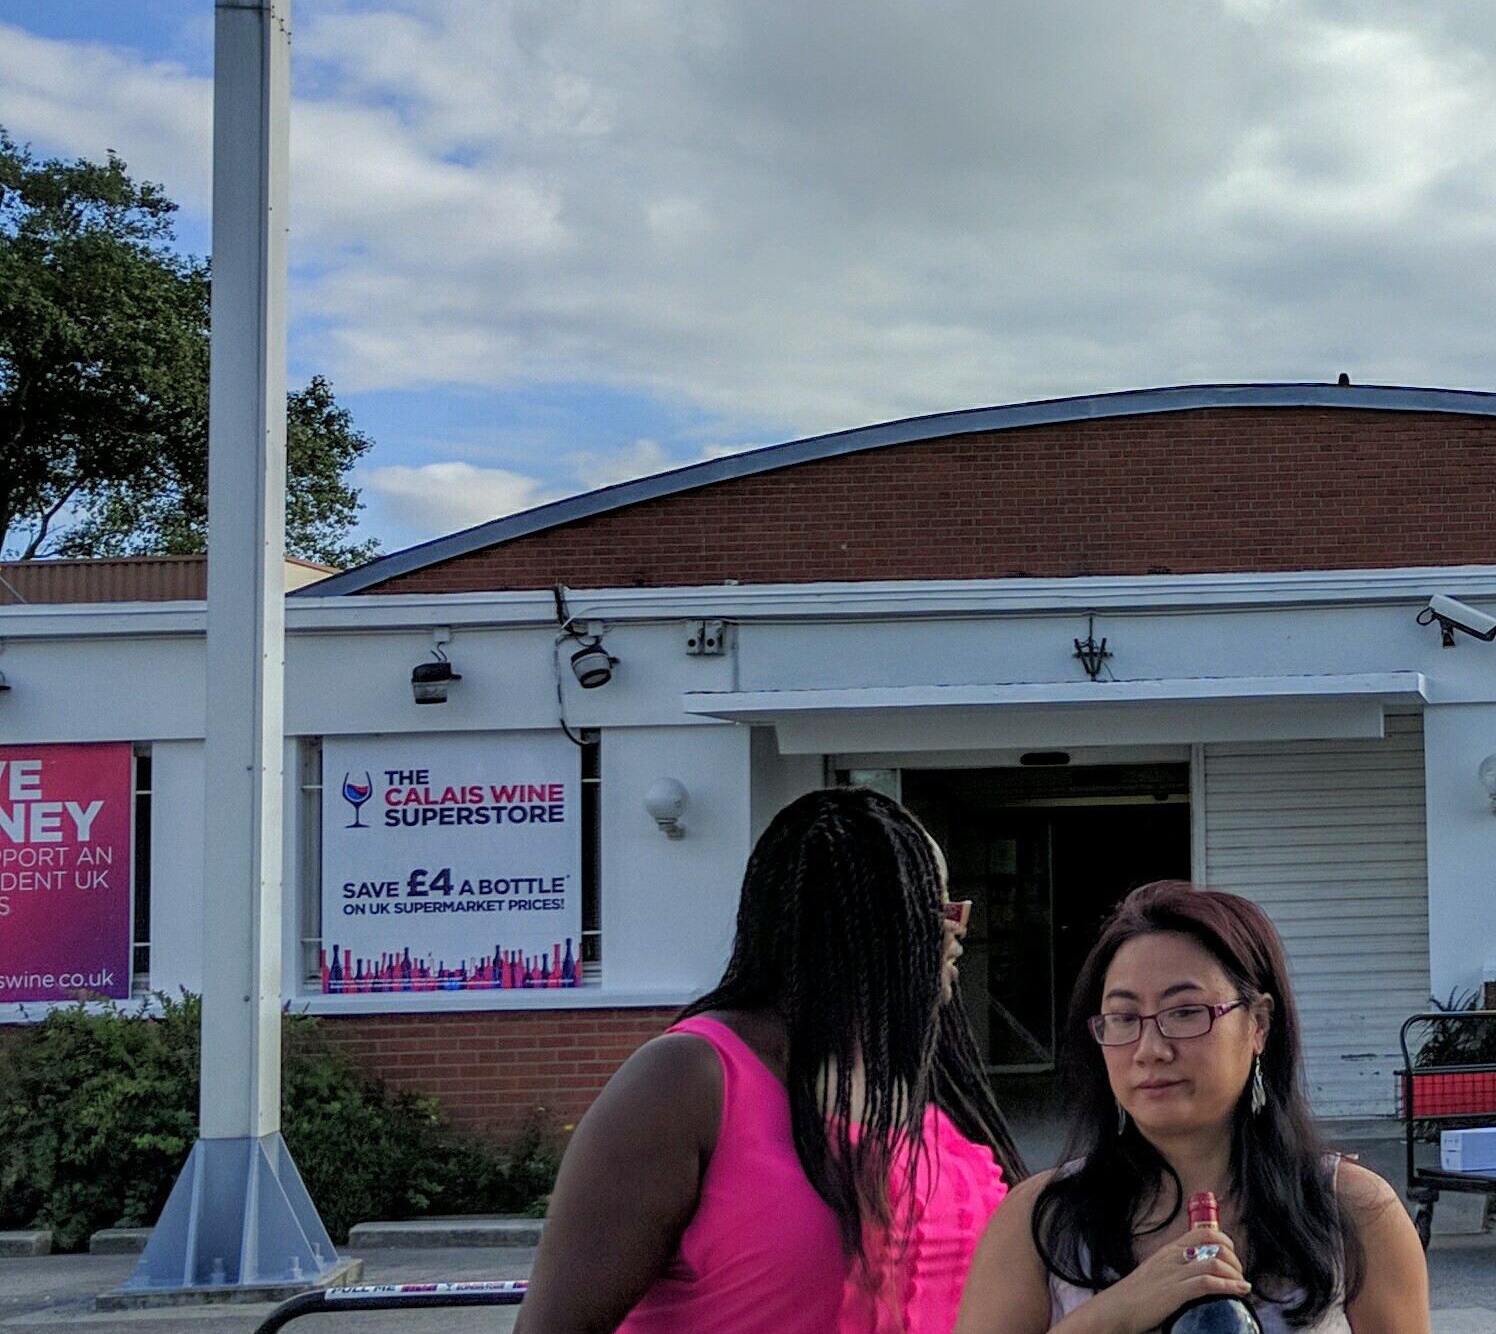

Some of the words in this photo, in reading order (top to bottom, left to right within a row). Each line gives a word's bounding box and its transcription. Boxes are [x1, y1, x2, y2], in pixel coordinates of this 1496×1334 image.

[385, 770, 429, 786] THE
[385, 786, 484, 807] CALAIS
[490, 784, 564, 803] WINE
[385, 804, 565, 827] SUPERSTORE
[0, 847, 69, 867] PORT
[77, 846, 112, 866] AN
[75, 870, 110, 889] UK
[343, 880, 400, 899] SAVE
[407, 868, 454, 897] £4
[459, 880, 475, 896] A
[343, 903, 367, 915] ON
[369, 902, 391, 914] UK
[394, 900, 505, 914] SUPERMARKET
[509, 898, 565, 911] PRICES!
